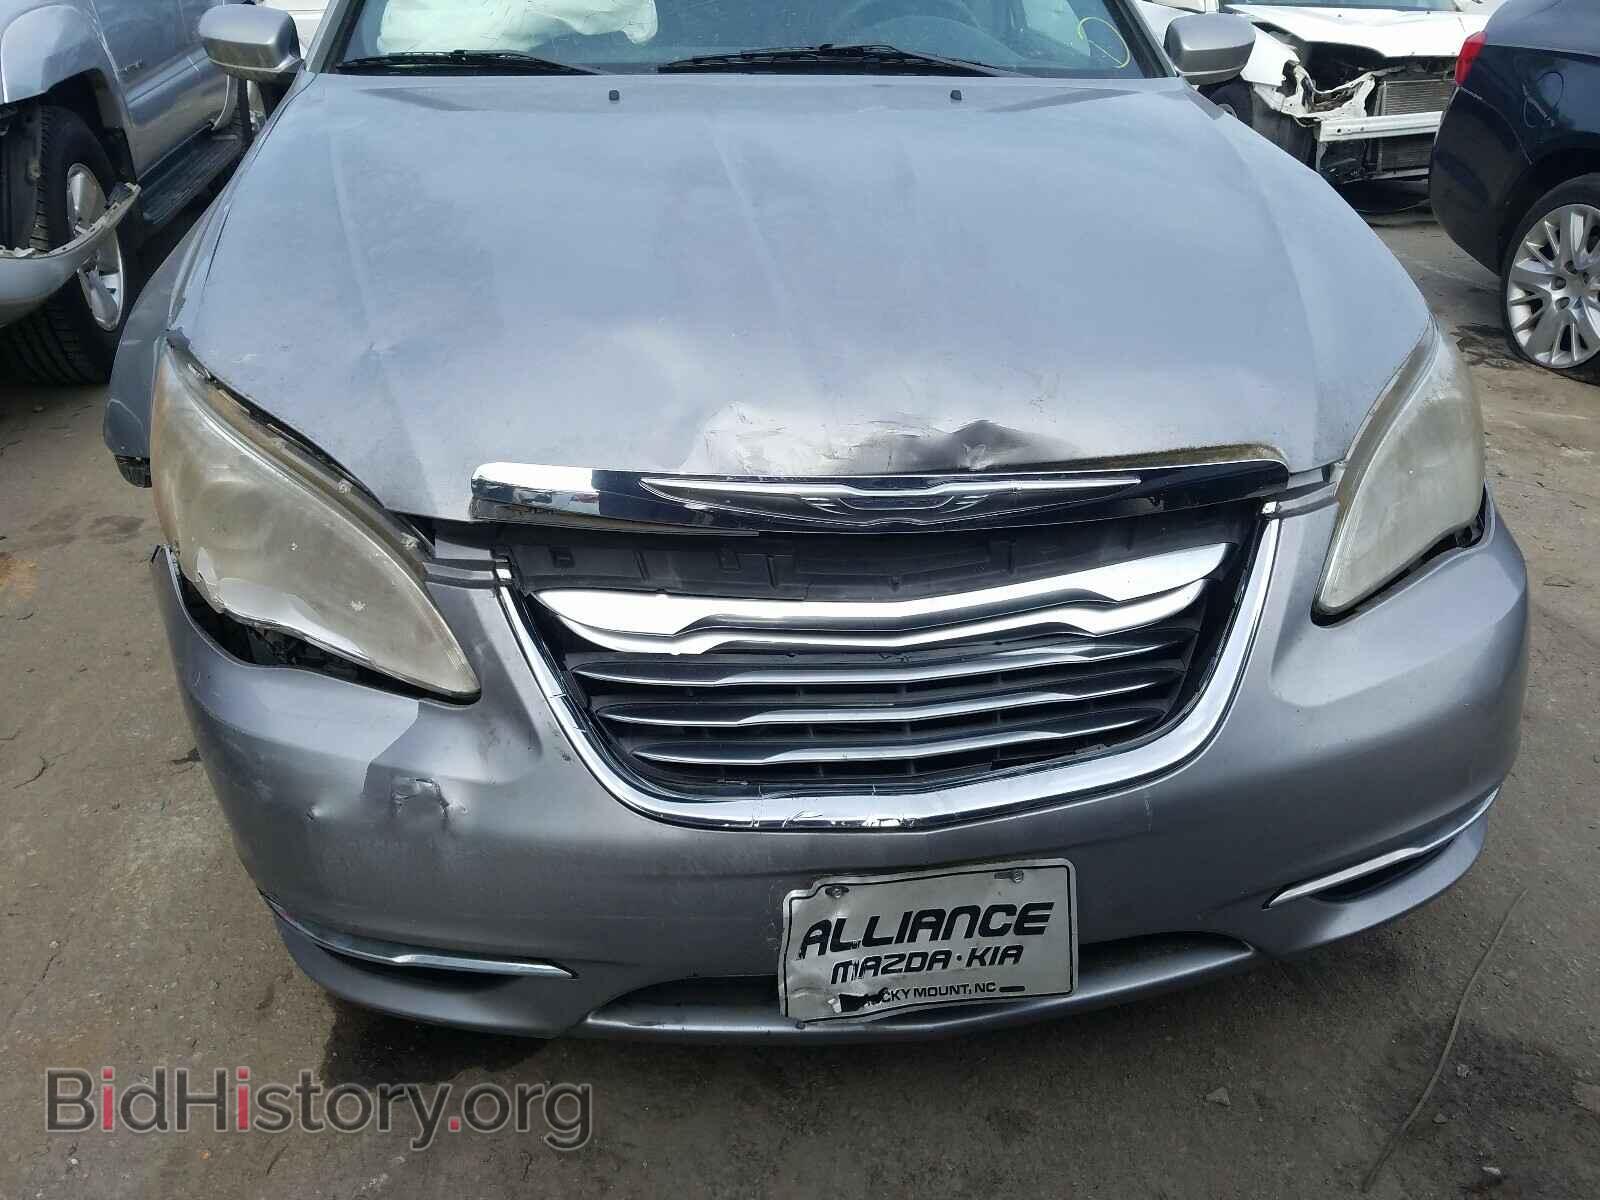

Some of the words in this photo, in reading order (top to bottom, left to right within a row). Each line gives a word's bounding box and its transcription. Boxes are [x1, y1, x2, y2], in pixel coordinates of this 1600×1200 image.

[798, 902, 1055, 960] ALLIANCE
[831, 950, 952, 984] MAZDA
[966, 944, 1024, 968] KIA
[913, 982, 972, 998] MOUNT,
[975, 981, 997, 994] NC
